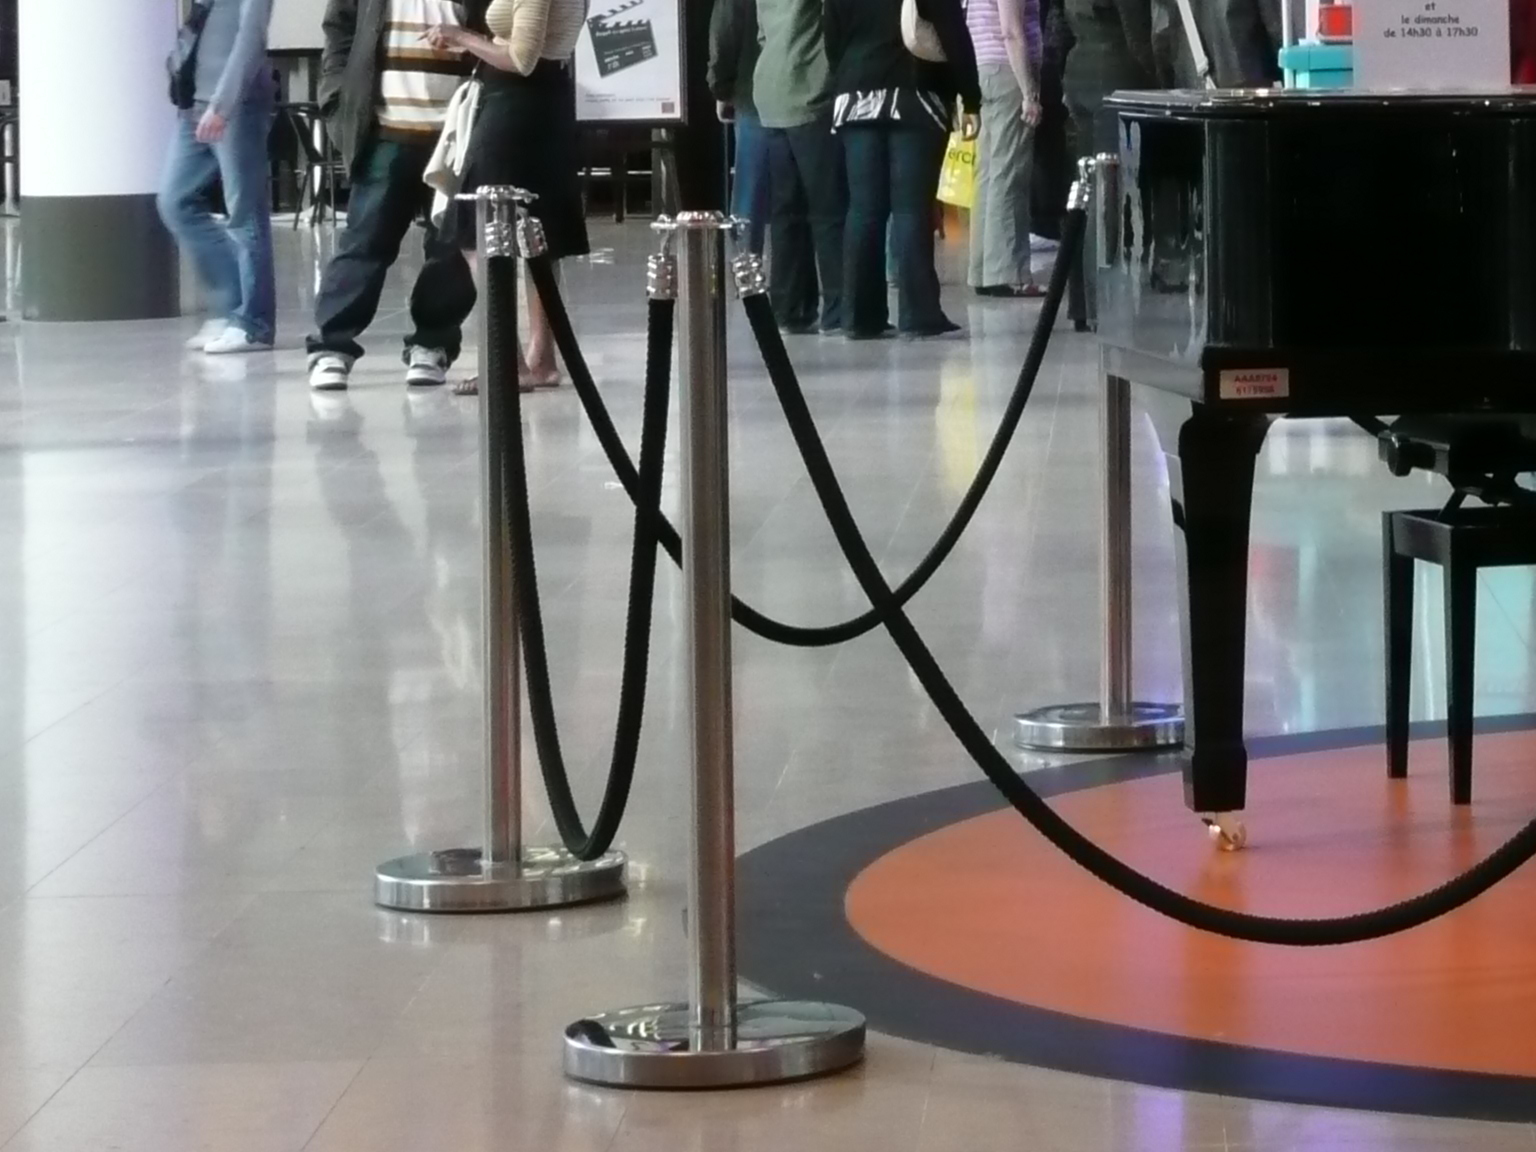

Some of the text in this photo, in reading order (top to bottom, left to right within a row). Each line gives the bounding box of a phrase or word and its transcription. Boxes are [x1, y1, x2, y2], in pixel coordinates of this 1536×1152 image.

[1424, 2, 1436, 11] et
[1401, 14, 1460, 24] le dimanche
[1383, 27, 1479, 38] de 14h30 à 17h30
